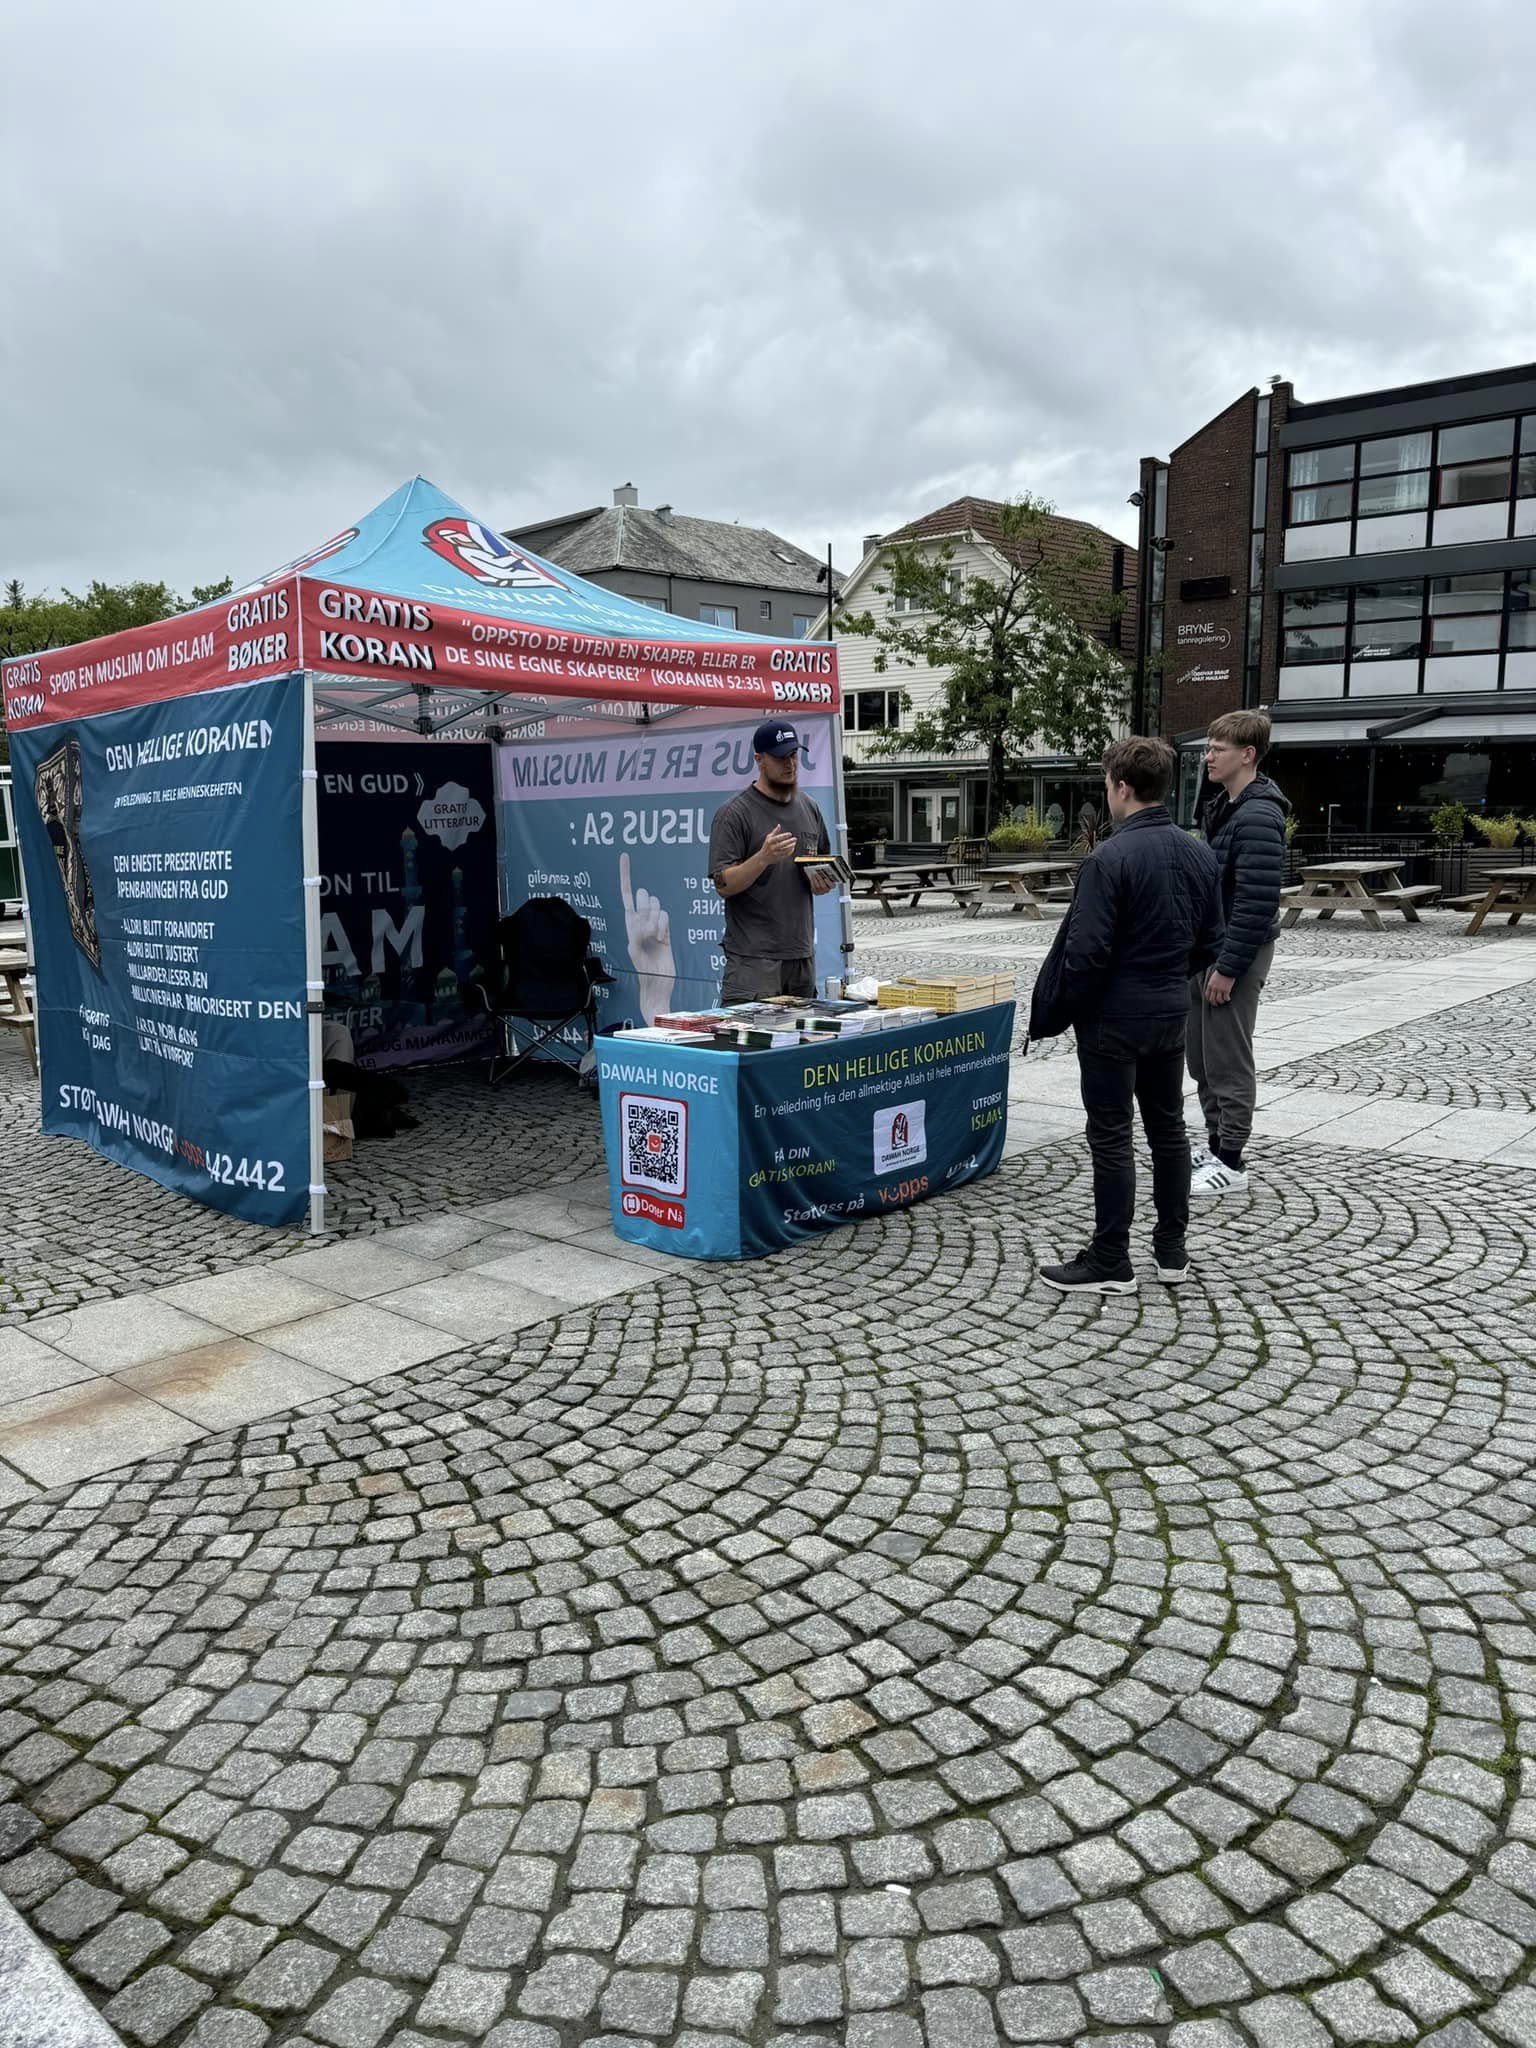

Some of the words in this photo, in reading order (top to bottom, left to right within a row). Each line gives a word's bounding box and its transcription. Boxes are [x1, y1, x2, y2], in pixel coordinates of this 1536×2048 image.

[227, 588, 289, 633] GRATIS
[319, 589, 433, 632] GRATIS
[1178, 622, 1215, 636] BRYNE
[49, 670, 76, 696] SPØR
[79, 664, 94, 688] EN
[96, 652, 142, 682] MUSLIM
[146, 647, 168, 672] OM
[172, 632, 214, 666] ISLAM
[227, 632, 288, 672] BØKER
[319, 630, 436, 671] KORAN
[546, 634, 571, 652] DE
[573, 640, 614, 659] UTEN
[618, 643, 639, 661] EN
[643, 646, 697, 667] SKAPER,
[701, 651, 737, 670] ELLER
[740, 655, 756, 671] ER
[770, 649, 832, 674] GRATIS
[6, 660, 41, 689] GRATIS
[445, 646, 471, 665] DE
[475, 650, 516, 670] SINE
[519, 655, 564, 676] EGNE
[651, 669, 724, 690] [KORANEN
[727, 675, 766, 693] 52:35]
[771, 680, 832, 704] BØKER
[8, 693, 45, 720] KORAN
[106, 744, 132, 772] DEN
[323, 773, 353, 794] EN
[114, 855, 130, 873] DEN
[131, 853, 163, 873] ENESTE
[164, 850, 232, 873] PRESERVERTE
[180, 880, 199, 899] FRA
[201, 879, 228, 899] GUD
[361, 872, 400, 894] TIL
[144, 919, 162, 936] BLITT
[164, 921, 215, 940] FORANDRET
[145, 943, 163, 960] BLITT
[258, 1000, 301, 1019] DEN
[92, 1035, 111, 1051] DAG
[803, 1062, 839, 1089] DEN
[846, 1048, 909, 1080] HELLIGE
[914, 1031, 985, 1066] KORANEN
[601, 1063, 657, 1084] DAWAH
[662, 1070, 719, 1094] NORGE
[754, 1104, 767, 1118] En
[771, 1096, 821, 1116] veiledning
[824, 1092, 835, 1105] fra
[838, 1089, 856, 1102] den
[858, 1078, 902, 1097] allmektige
[904, 1072, 925, 1088] Allah
[927, 1069, 935, 1082] til
[936, 1065, 951, 1079] hele
[132, 1113, 174, 1155] NORGE
[788, 1146, 810, 1160] DIN
[846, 1193, 865, 1212] på
